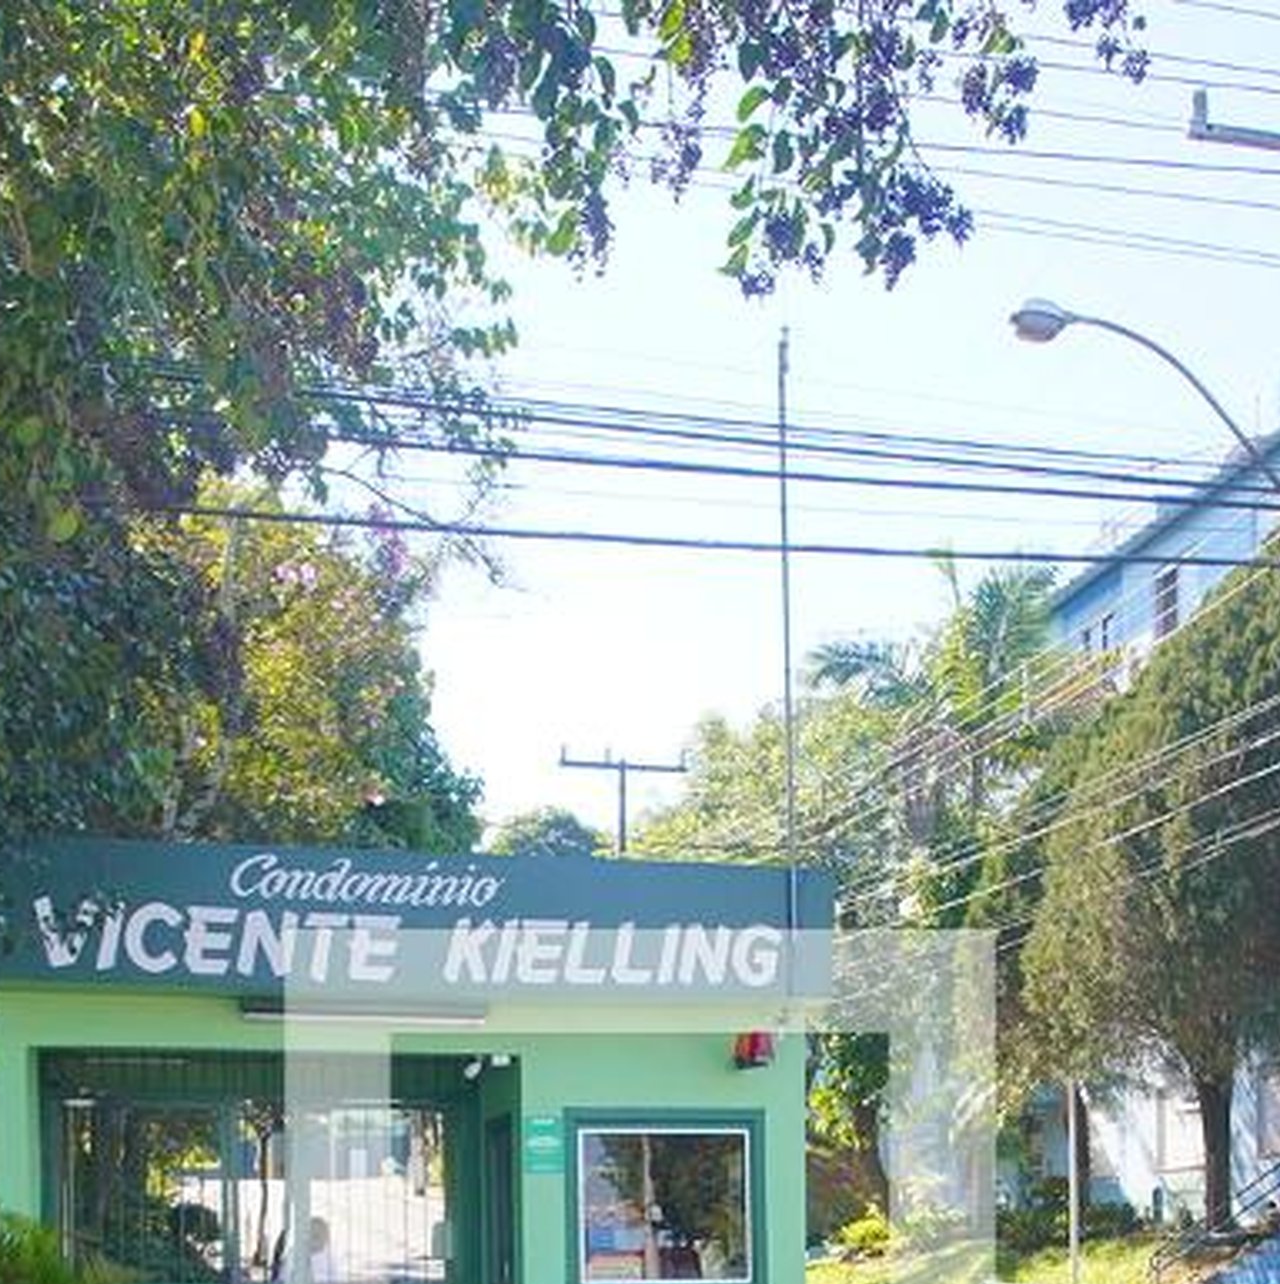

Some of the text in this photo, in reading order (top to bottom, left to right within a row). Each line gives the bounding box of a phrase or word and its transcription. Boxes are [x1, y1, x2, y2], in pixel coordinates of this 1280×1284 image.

[231, 854, 505, 907] Condomínio
[33, 895, 782, 987] VICENTE KIELLING
